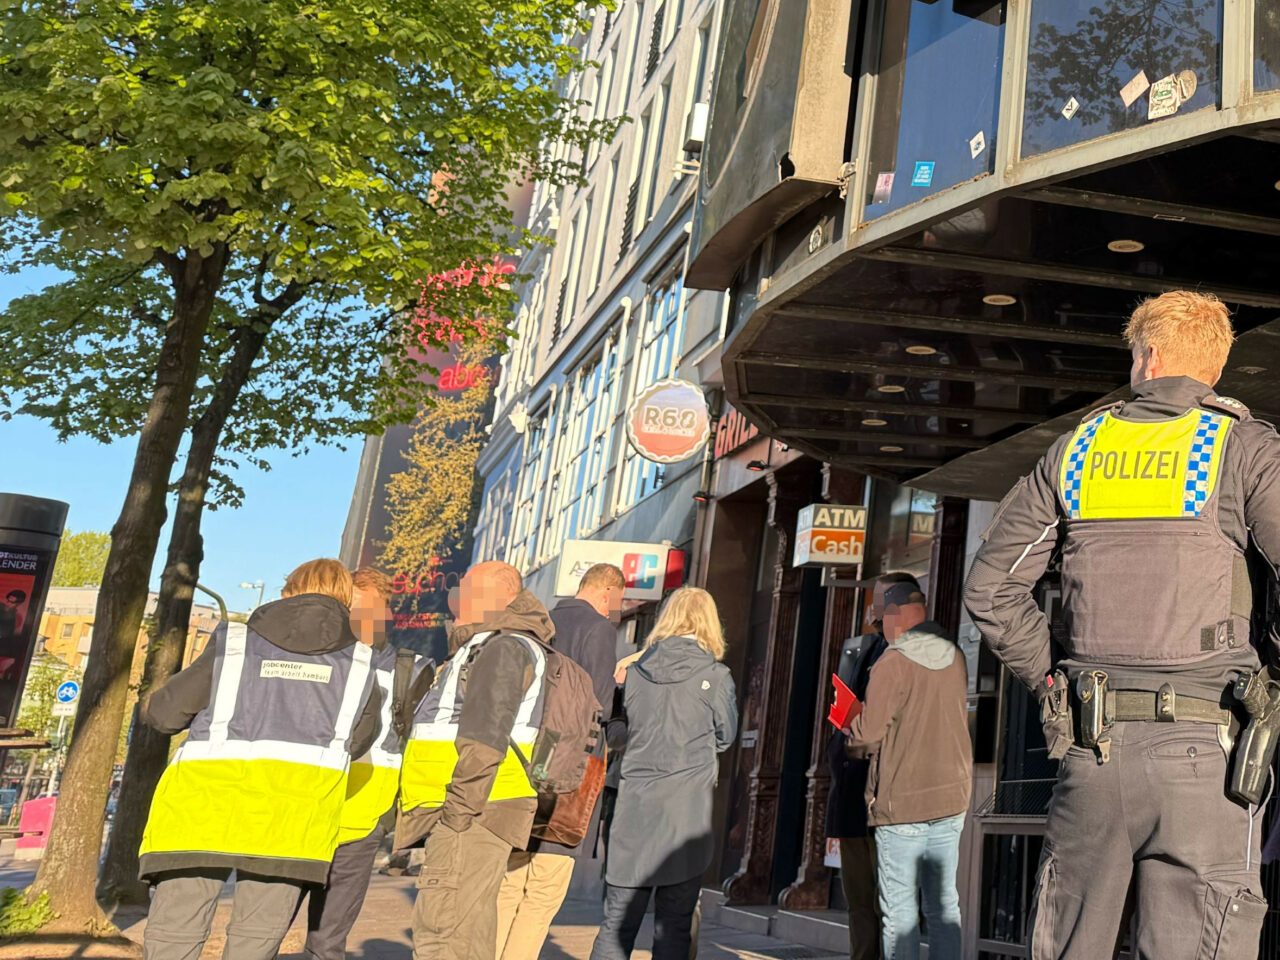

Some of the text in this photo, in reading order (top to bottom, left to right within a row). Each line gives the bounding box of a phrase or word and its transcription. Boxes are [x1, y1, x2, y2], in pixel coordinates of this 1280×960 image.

[1089, 450, 1180, 480] POLIZEI
[814, 507, 866, 528] ATM
[811, 535, 864, 557] Cash
[262, 662, 303, 670] jobcenter
